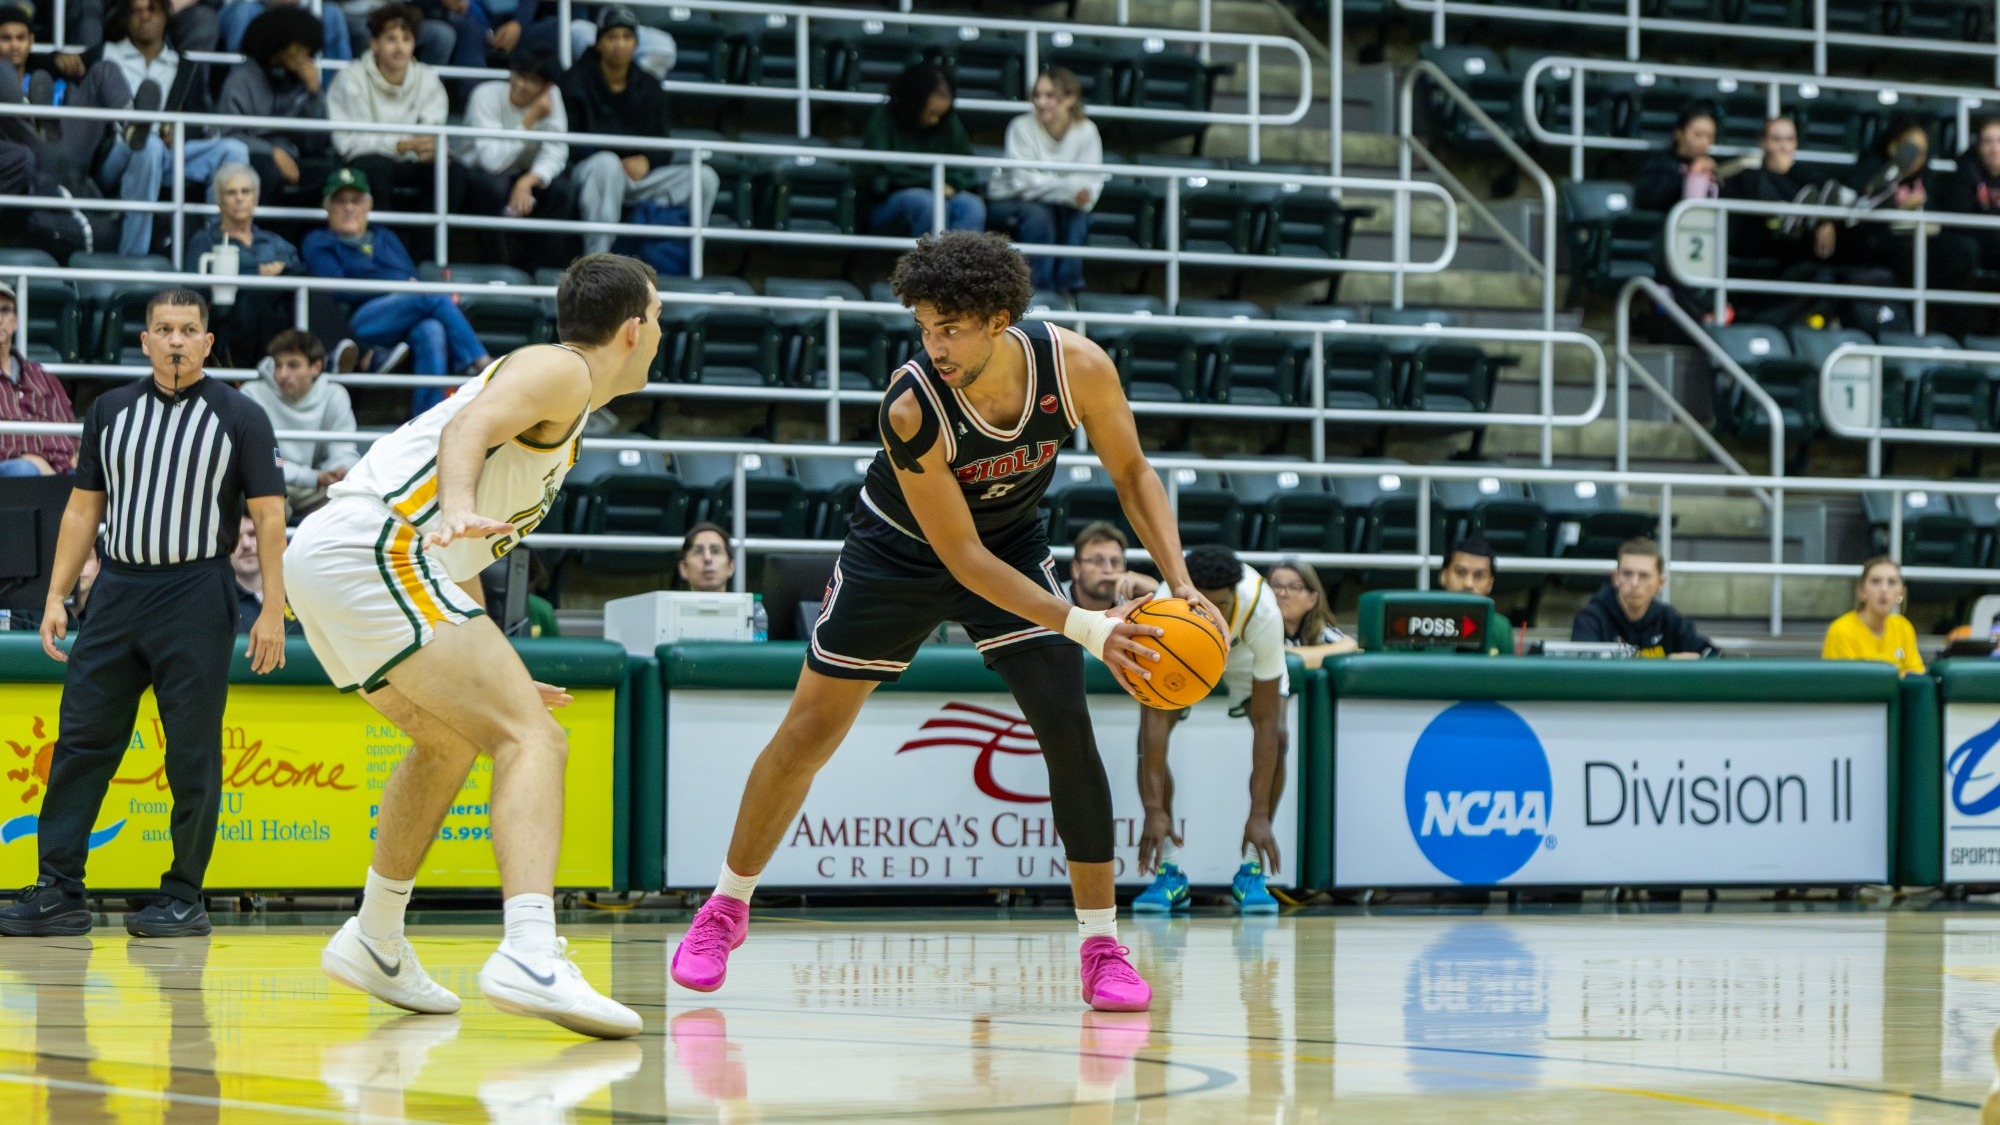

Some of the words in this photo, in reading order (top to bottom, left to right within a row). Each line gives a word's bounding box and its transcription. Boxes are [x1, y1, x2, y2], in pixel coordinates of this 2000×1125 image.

[1688, 236, 1705, 262] 2
[1844, 385, 1855, 410] 1
[130, 730, 146, 749] A
[111, 740, 358, 791] lcome
[1584, 759, 1806, 826] Division
[129, 798, 168, 814] from
[1421, 791, 1547, 836] NCAA
[261, 820, 330, 841] Hotels
[791, 812, 979, 847] AMERICA'S
[817, 856, 983, 878] CREDIT
